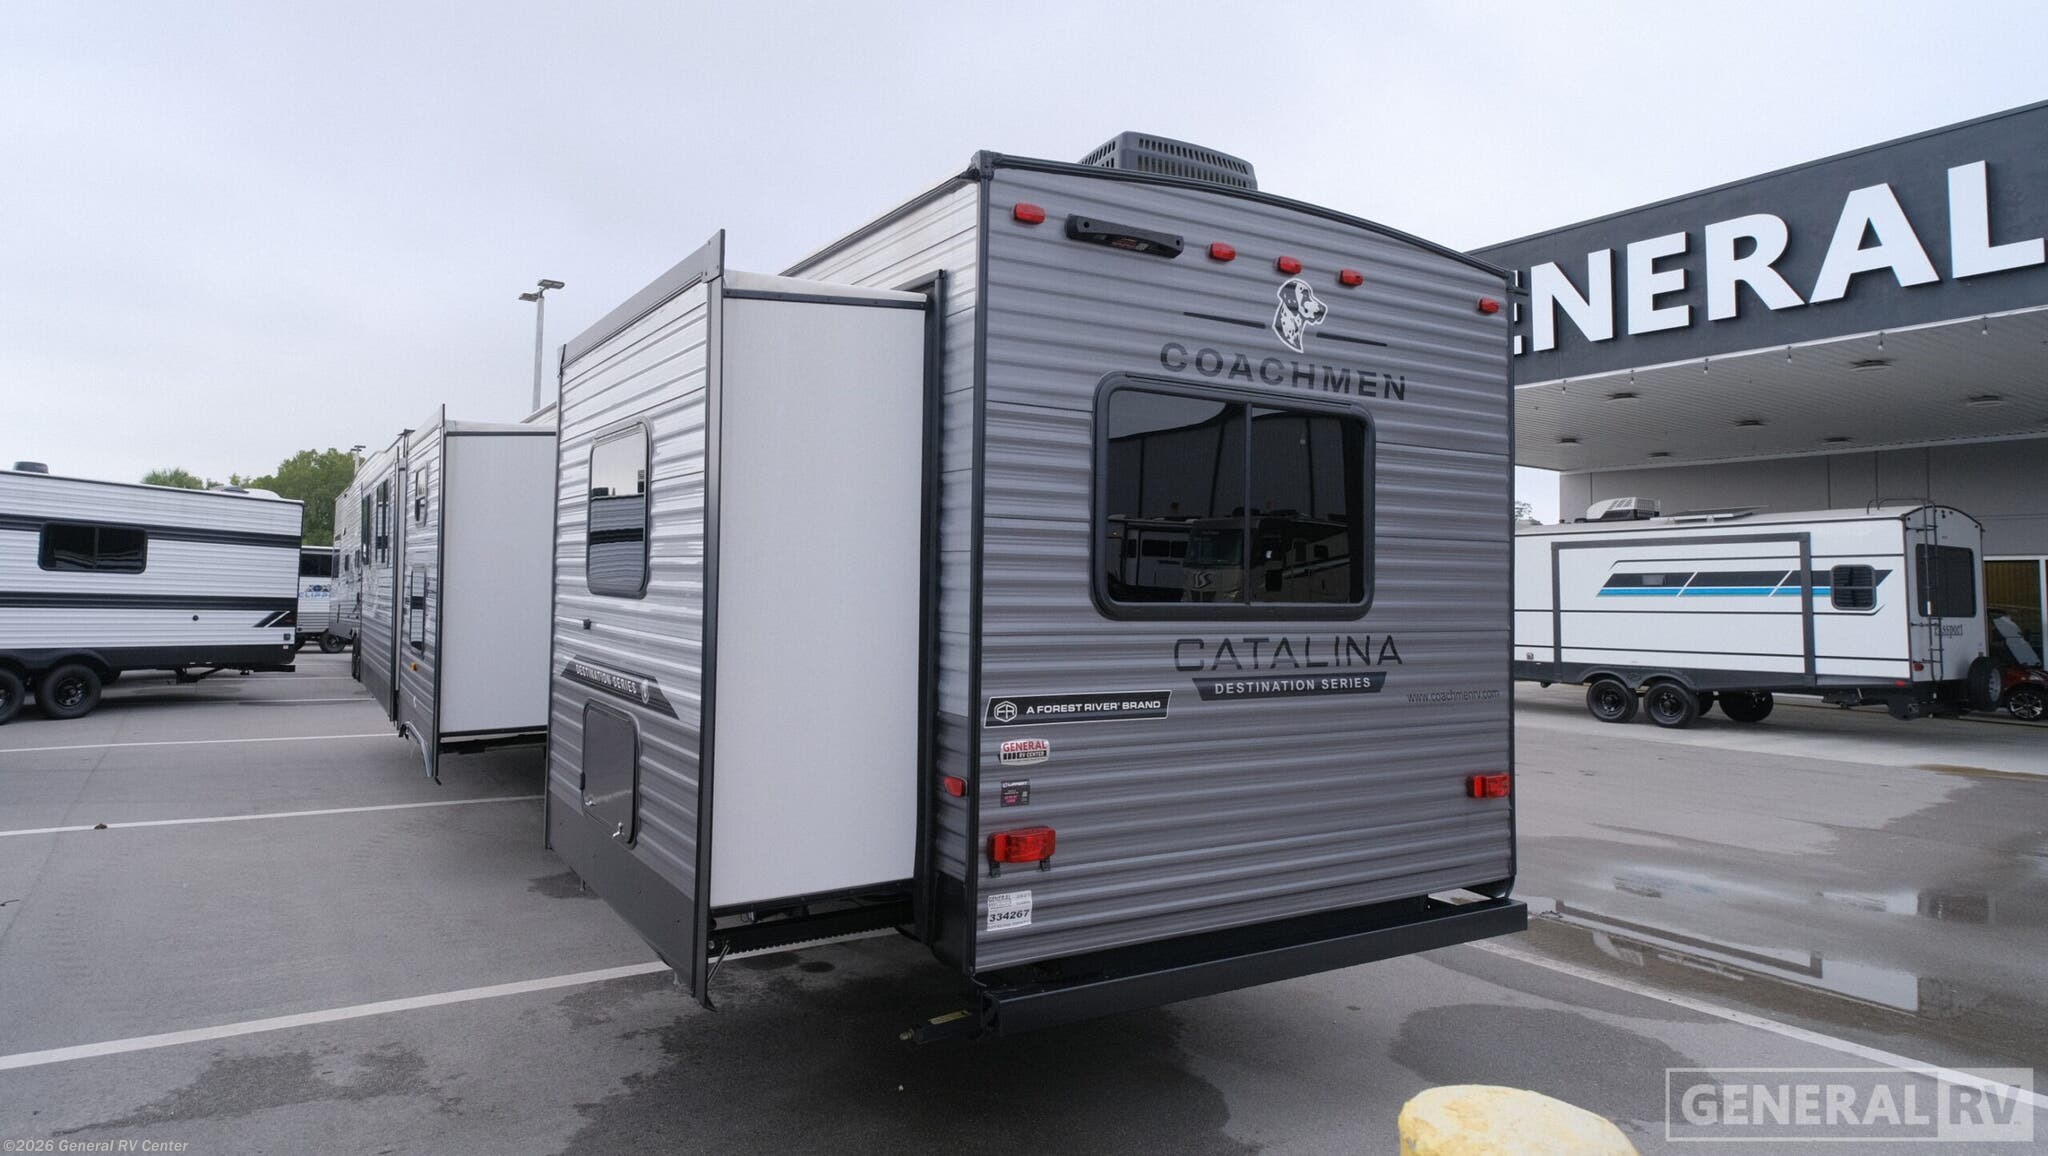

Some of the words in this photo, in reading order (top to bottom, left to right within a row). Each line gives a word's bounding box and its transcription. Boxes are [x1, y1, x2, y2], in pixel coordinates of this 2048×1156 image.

[1514, 160, 2045, 355] NERAL
[1160, 342, 1405, 400] COACHMEN
[1174, 635, 1403, 671] CATALINA
[575, 664, 612, 686] DESTINATION
[612, 676, 637, 694] SERIES
[1215, 679, 1315, 694] DESTINATION
[1321, 677, 1371, 689] SERIES
[1406, 689, 1500, 703] www.coachmenrv.com
[1026, 706, 1035, 714] A
[1037, 704, 1083, 714] FOREST
[1122, 701, 1161, 710] BRAND
[1003, 741, 1047, 753] GENERAL
[990, 909, 1030, 922] 334267
